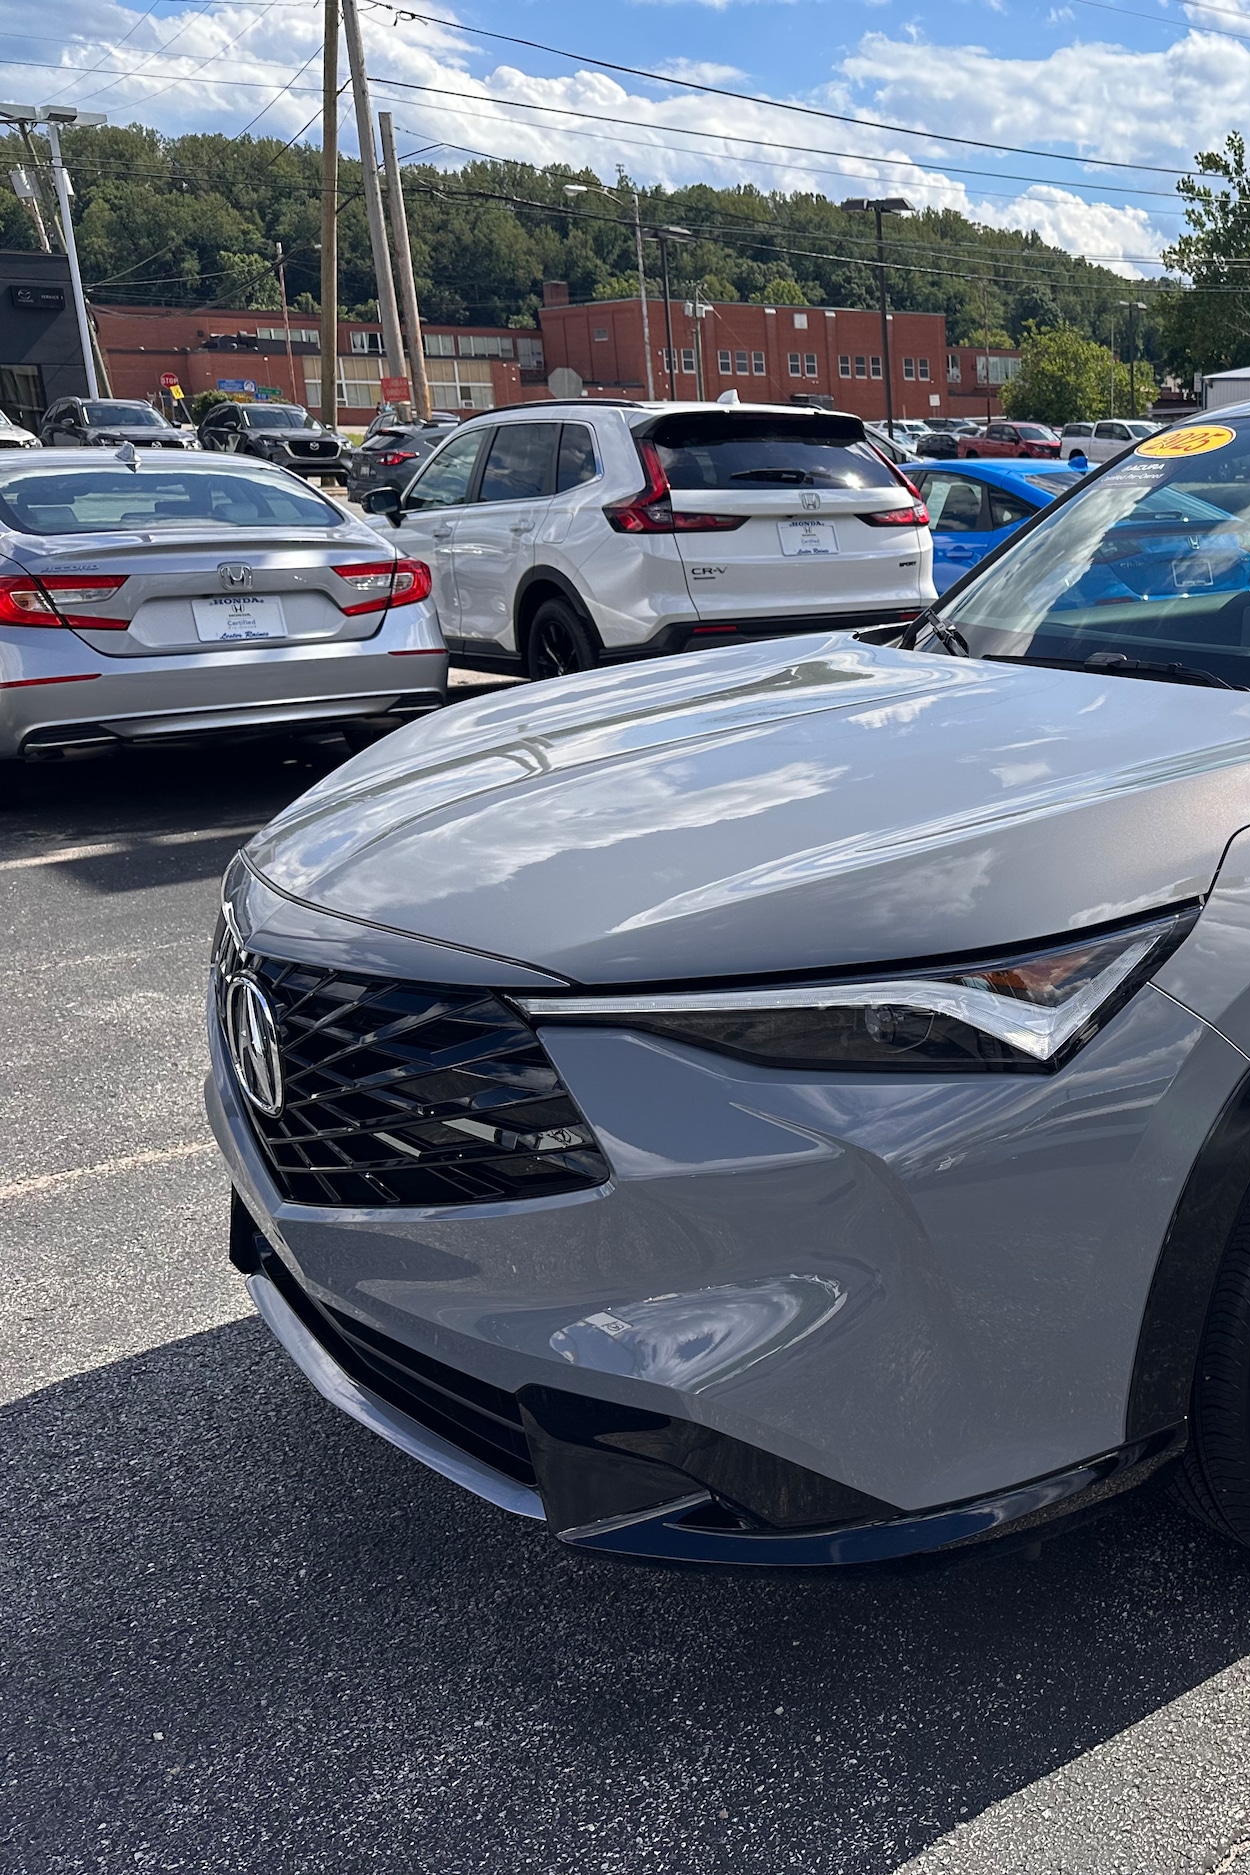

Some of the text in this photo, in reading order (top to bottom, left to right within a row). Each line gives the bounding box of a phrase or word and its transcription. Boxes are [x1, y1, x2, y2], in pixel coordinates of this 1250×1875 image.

[161, 377, 179, 385] STOP
[1143, 432, 1226, 452] 2025
[1127, 463, 1165, 471] ACURA
[41, 564, 100, 574] ACCORD
[691, 566, 728, 575] CR-V
[213, 597, 260, 606] HONDA
[227, 619, 256, 627] Certified
[219, 630, 269, 640] Lester Raines
